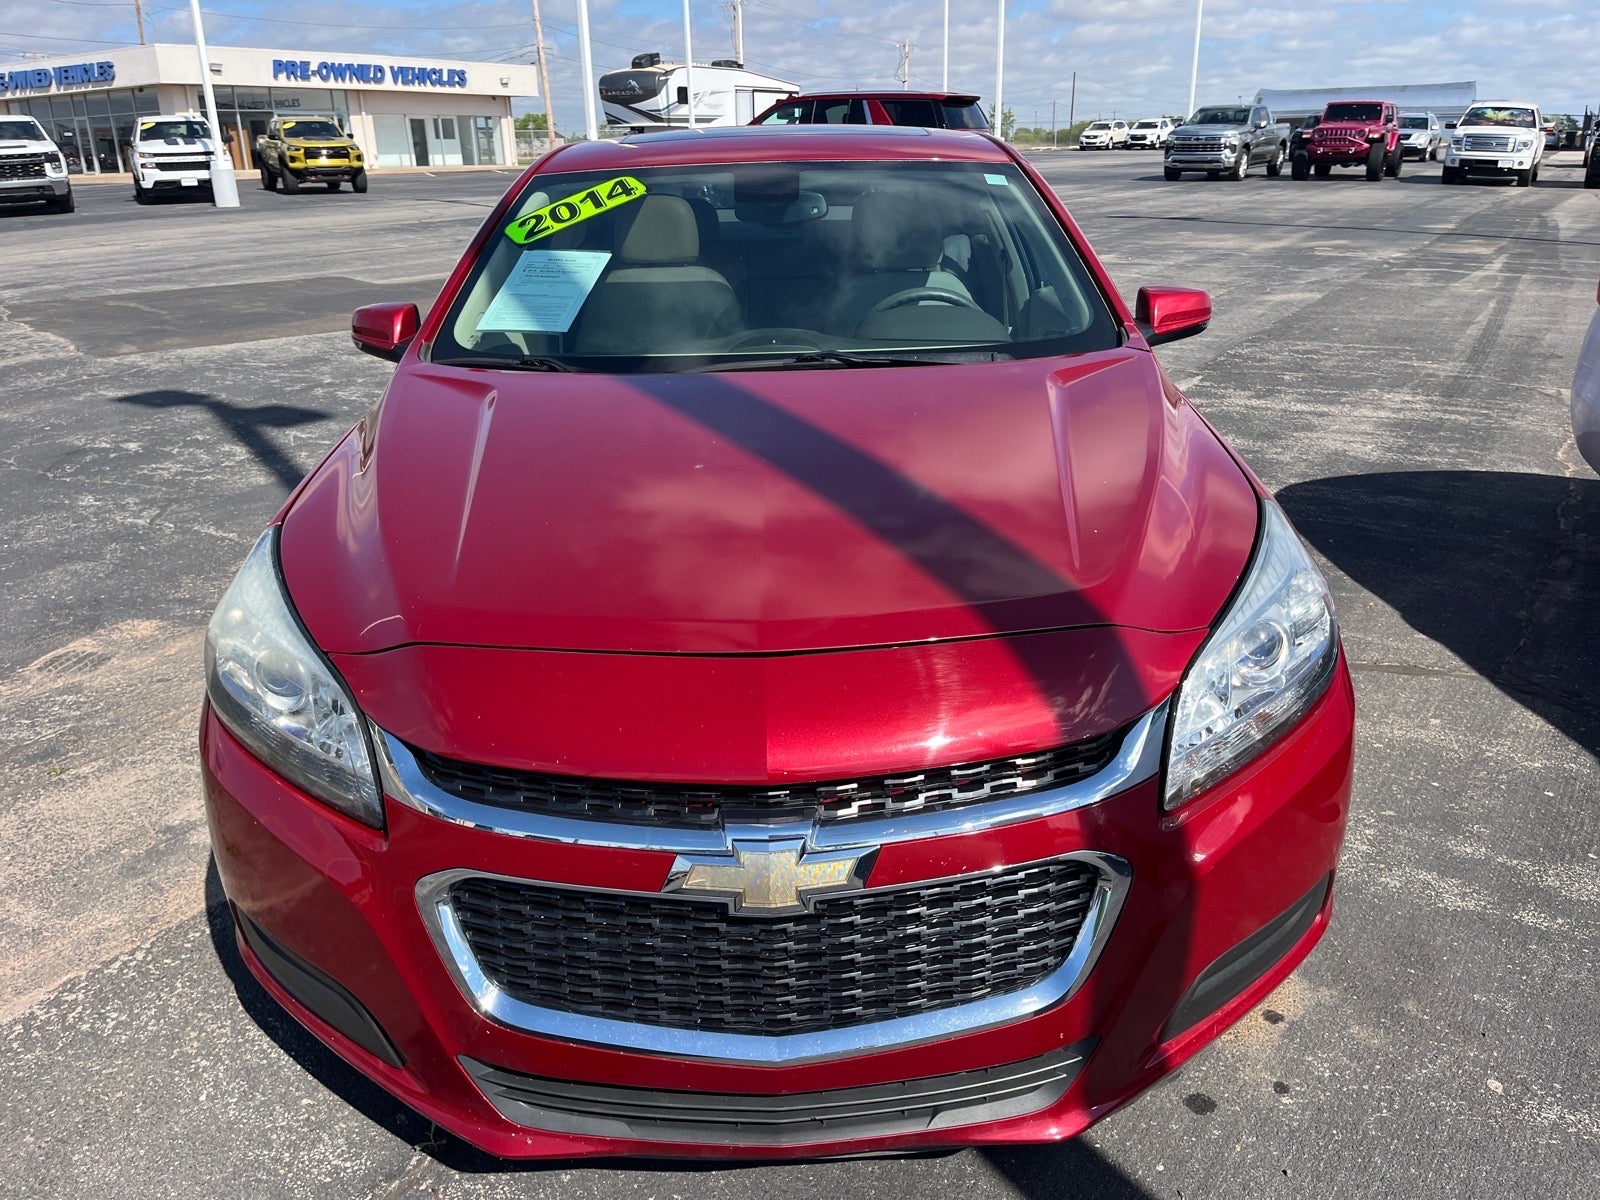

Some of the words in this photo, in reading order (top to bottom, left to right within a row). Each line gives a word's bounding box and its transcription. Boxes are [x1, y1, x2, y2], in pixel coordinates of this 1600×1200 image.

[53, 61, 116, 86] VEHICLES
[272, 58, 385, 84] PRE-OWNED
[389, 65, 467, 87] VEHICLES
[517, 178, 638, 242] 2014
